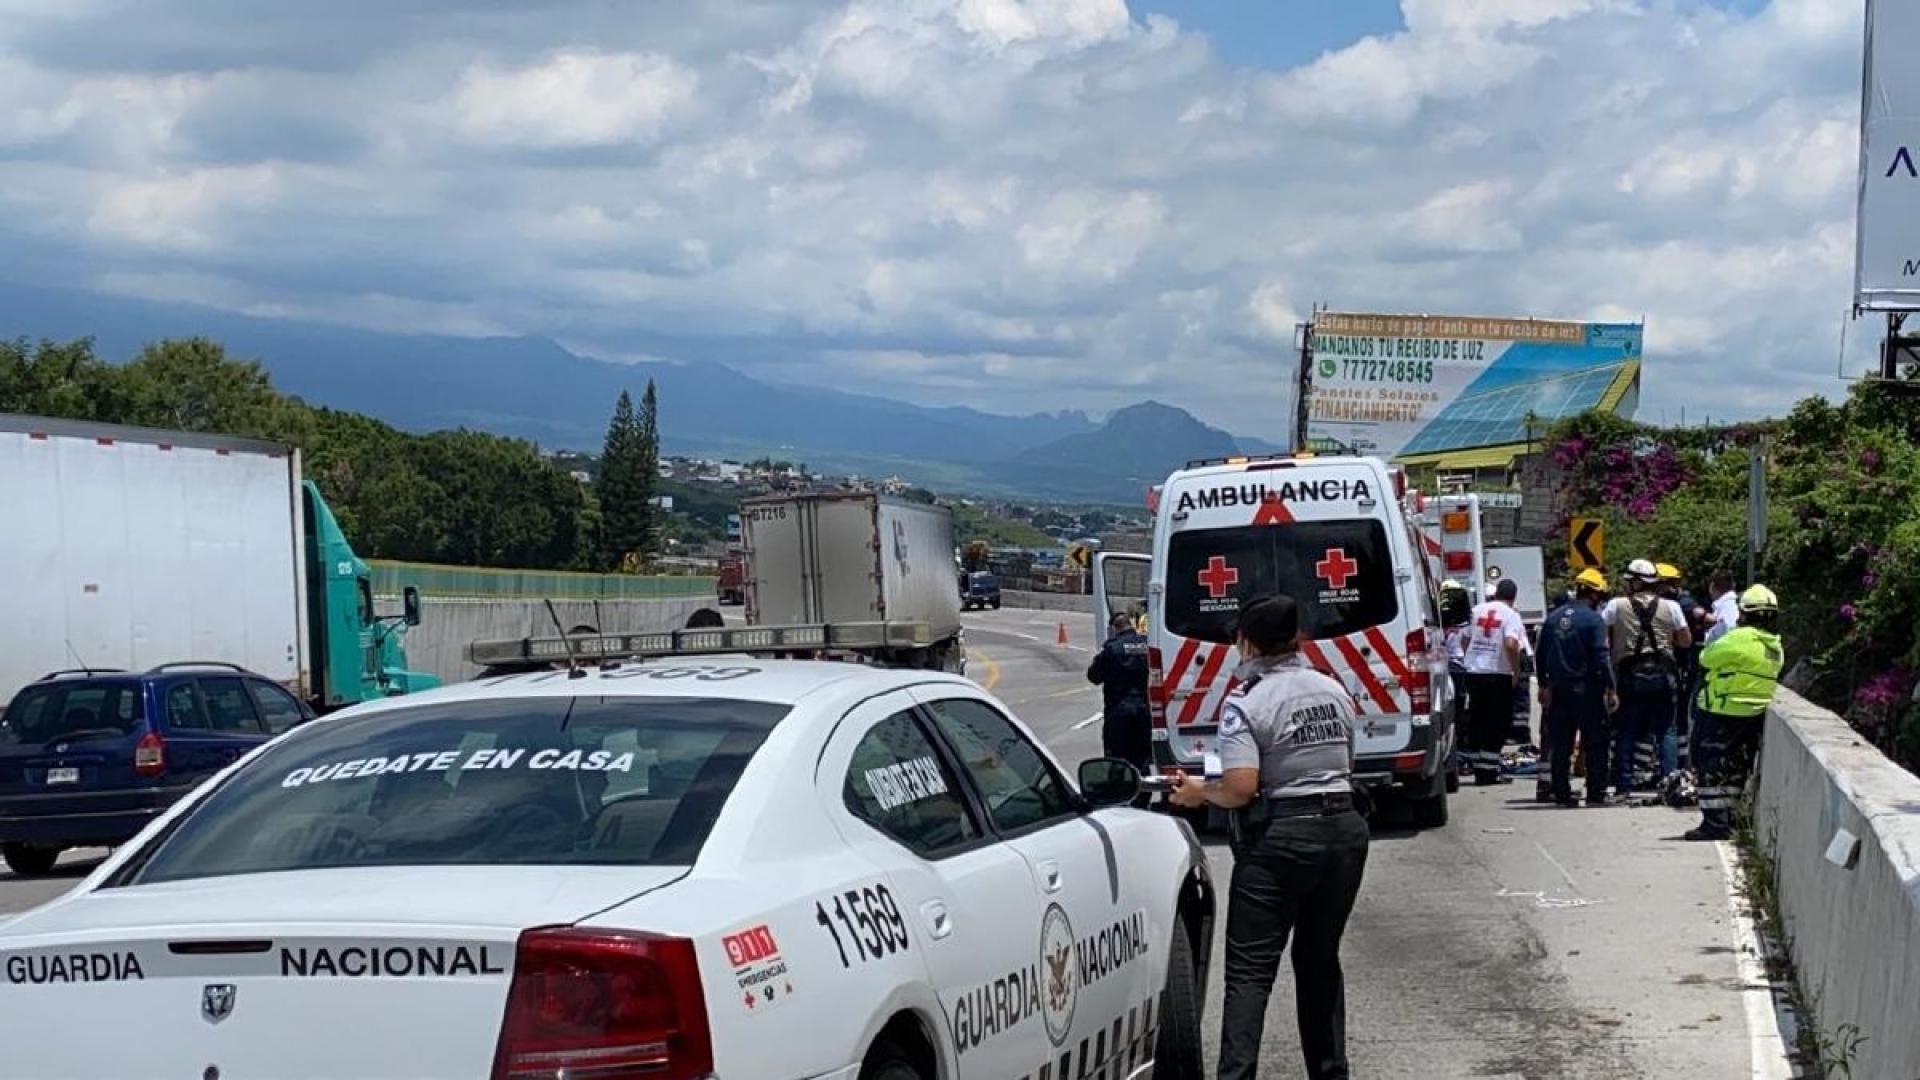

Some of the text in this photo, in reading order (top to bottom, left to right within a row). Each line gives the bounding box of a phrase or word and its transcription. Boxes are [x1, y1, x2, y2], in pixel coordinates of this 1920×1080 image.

[1313, 335, 1484, 361] MANDANOS TU RECIBO DE LUZ
[1342, 358, 1434, 383] 7772748545
[1378, 388, 1439, 402] Solares
[1177, 480, 1371, 511] AMBULANCIA
[1291, 703, 1337, 725] GUARDIA
[1293, 721, 1344, 744] NACIONAL
[282, 749, 635, 788] QUEDATE EN CASA
[816, 883, 909, 969] 11569
[727, 928, 775, 962] 911
[7, 946, 504, 984] GUARDIA NACIONAL
[954, 964, 1041, 1055] GUARDIA
[1076, 911, 1149, 989] NACIONAL
